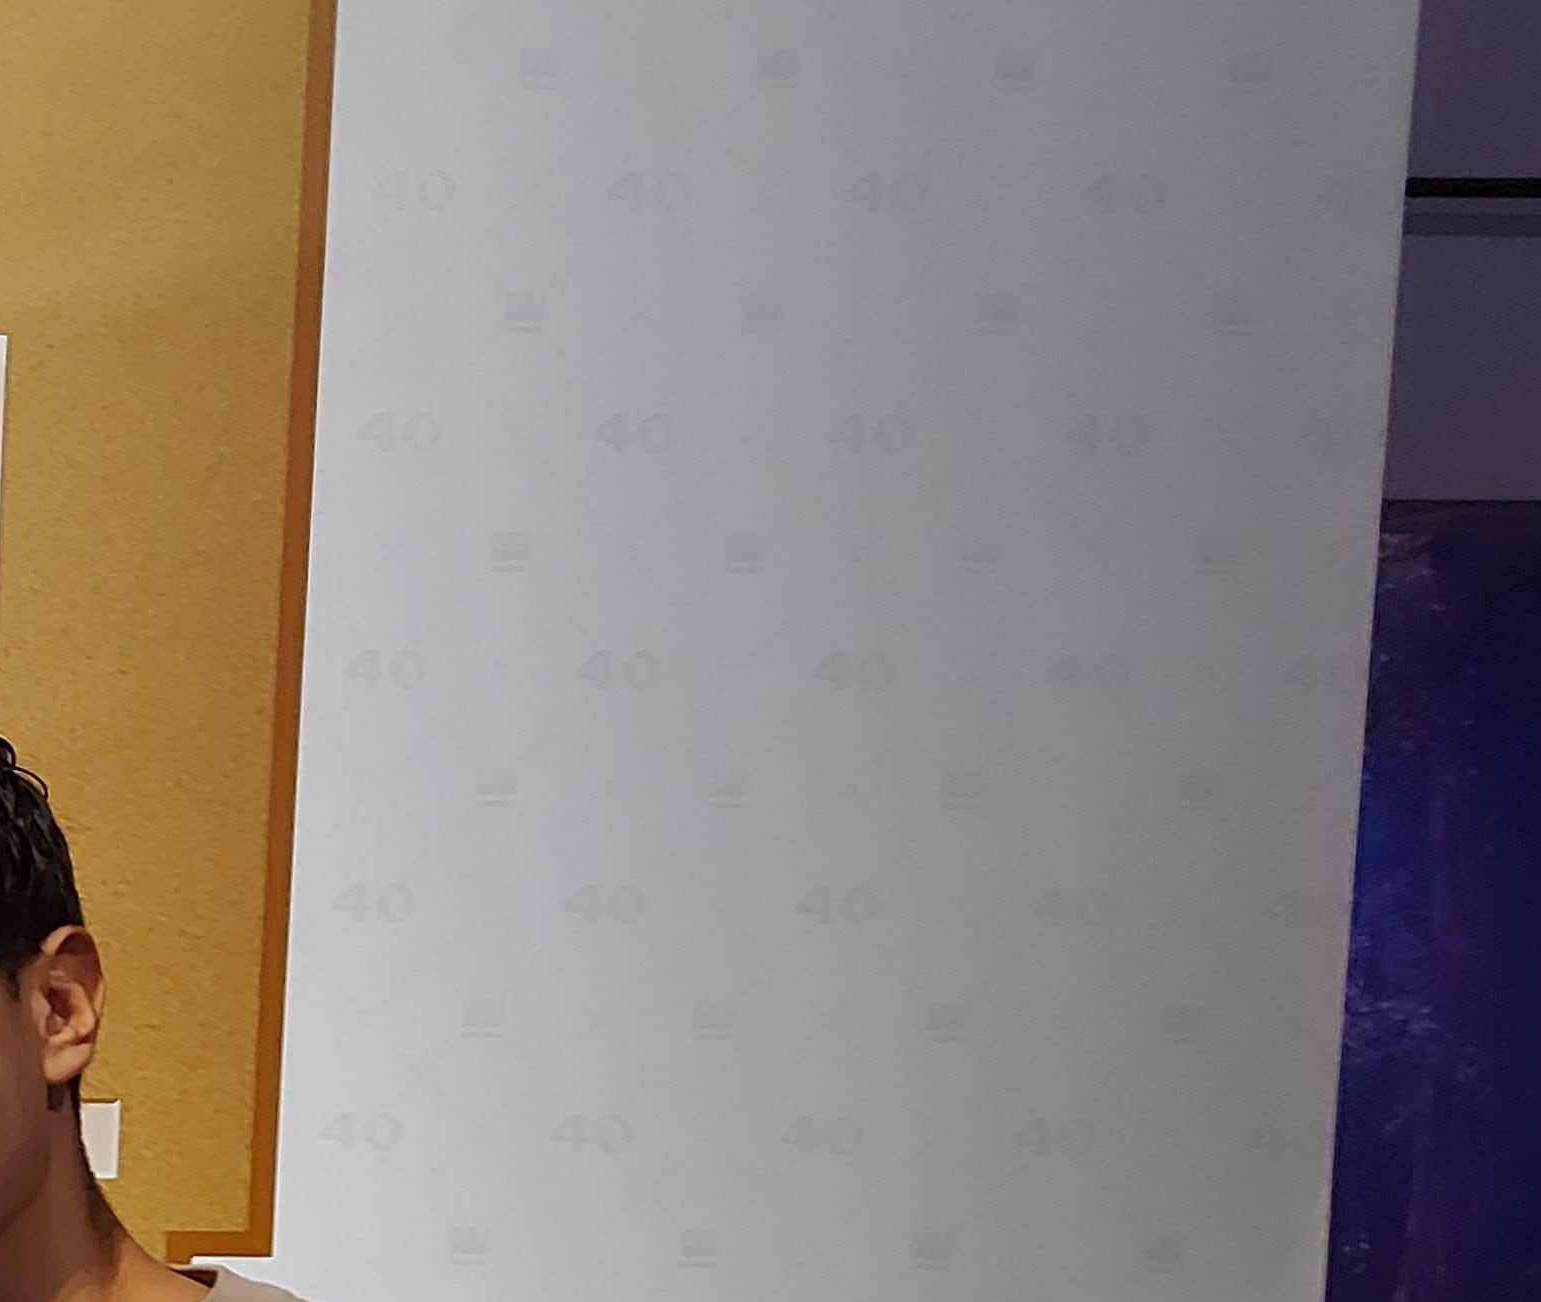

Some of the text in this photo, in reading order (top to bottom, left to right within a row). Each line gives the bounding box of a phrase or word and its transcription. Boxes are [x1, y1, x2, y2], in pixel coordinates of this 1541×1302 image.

[371, 168, 457, 211] 40
[607, 169, 693, 212] 40
[844, 170, 930, 213] 40
[1082, 172, 1168, 215] 40
[357, 410, 443, 453] 40
[592, 411, 678, 454] 40
[827, 412, 913, 455] 40
[1064, 413, 1150, 456] 40
[344, 647, 430, 690] 40
[576, 649, 662, 692] 40
[810, 650, 896, 693] 40
[1046, 651, 1132, 694] 40
[331, 880, 417, 923] 40
[562, 882, 648, 925] 40
[794, 884, 880, 927] 40
[1028, 885, 1114, 928] 40
[320, 1110, 404, 1151] 40
[550, 1112, 634, 1153] 40
[781, 1114, 865, 1155] 40
[1013, 1116, 1097, 1157] 40
